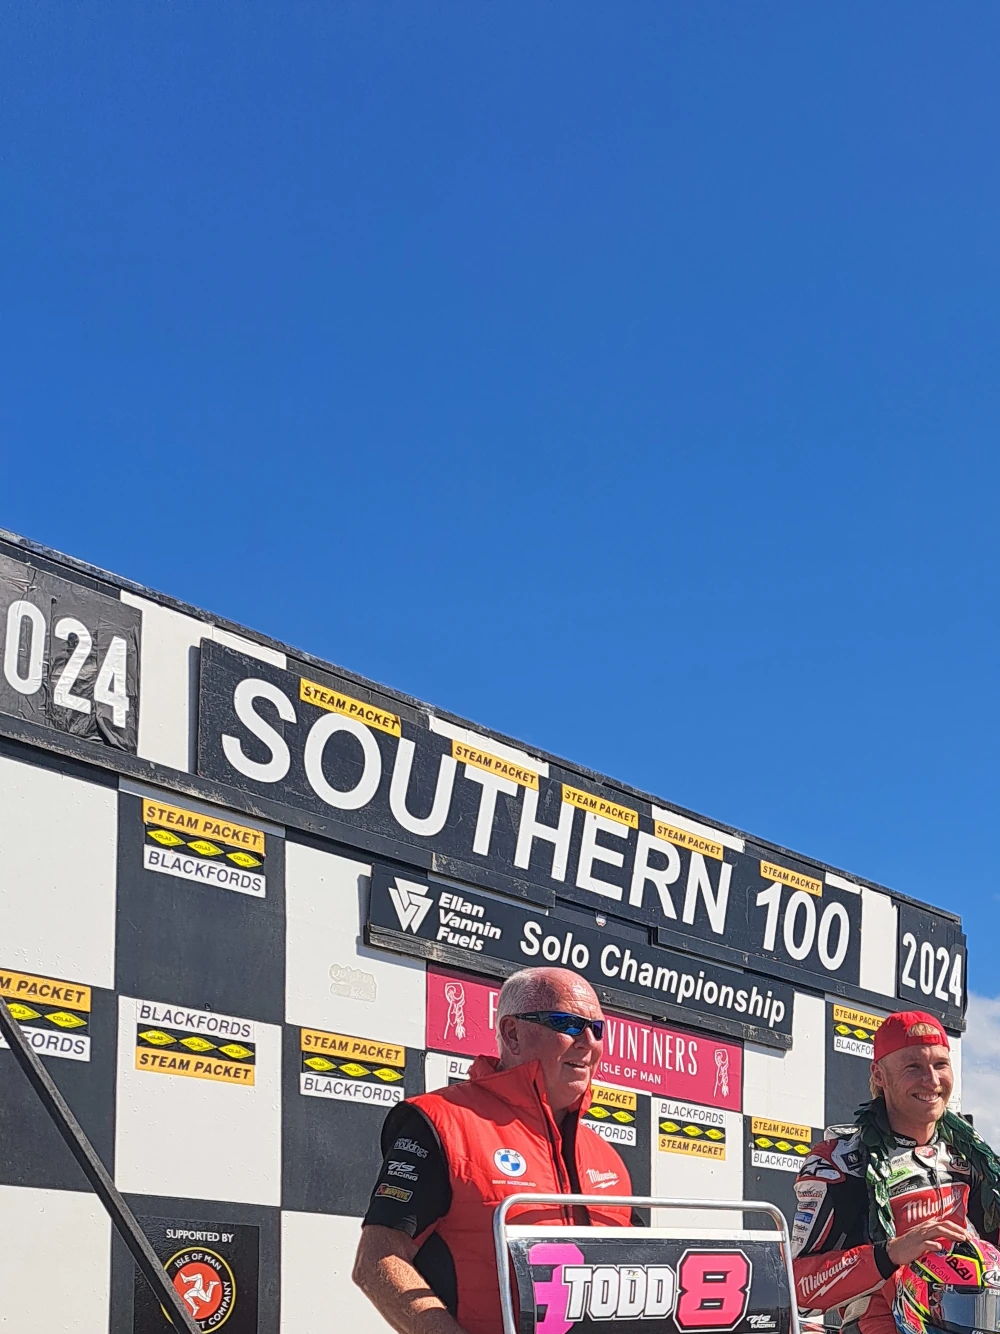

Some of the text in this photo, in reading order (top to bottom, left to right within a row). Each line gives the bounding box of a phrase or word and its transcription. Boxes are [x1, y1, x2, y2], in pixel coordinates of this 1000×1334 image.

[3, 600, 130, 729] 024
[304, 686, 399, 730] STEAM PACKET
[455, 745, 536, 784] STEAM PACKET
[564, 789, 636, 824] STEAM PACKET
[146, 806, 261, 846] STEAM PACKET
[222, 678, 850, 971] SOUTHERN 100
[656, 825, 721, 856] STEAM PACKET
[149, 851, 262, 891] BLACKFORDS
[762, 865, 820, 892] STEAM PACKET
[438, 892, 485, 917] Ellan
[438, 909, 501, 940] Vannin
[436, 926, 484, 951] Fuels
[520, 921, 785, 1028] Solo Championship
[901, 932, 964, 1007] 2024
[16, 980, 86, 1004] PACKET
[139, 1004, 251, 1037] BLACKFORDS
[835, 1008, 883, 1027] STEAM PACKE
[303, 1034, 401, 1060] STEAM PACKET
[607, 1019, 698, 1076] VINTNERS
[836, 1039, 874, 1055] BLACKFO
[139, 1053, 251, 1080] STEAM PACKET
[600, 1062, 661, 1084] ISLE OF MAN
[304, 1078, 401, 1103] BLACKFORDS
[597, 1090, 634, 1105] PACKET
[661, 1103, 724, 1124] BLACKFORDS
[753, 1121, 809, 1137] STEAM PACKET
[660, 1138, 724, 1156] STEAM PACKET
[754, 1152, 803, 1169] BLACKFORD
[387, 1171, 418, 1181] RACING
[166, 1229, 234, 1242] SUPPORTED BY
[174, 1254, 190, 1268] ISLE
[203, 1255, 222, 1270] MAN
[797, 1250, 862, 1298] Milwaukee
[208, 1281, 232, 1326] COMPANY
[562, 1264, 677, 1322] TODD
[672, 1249, 752, 1333] 8
